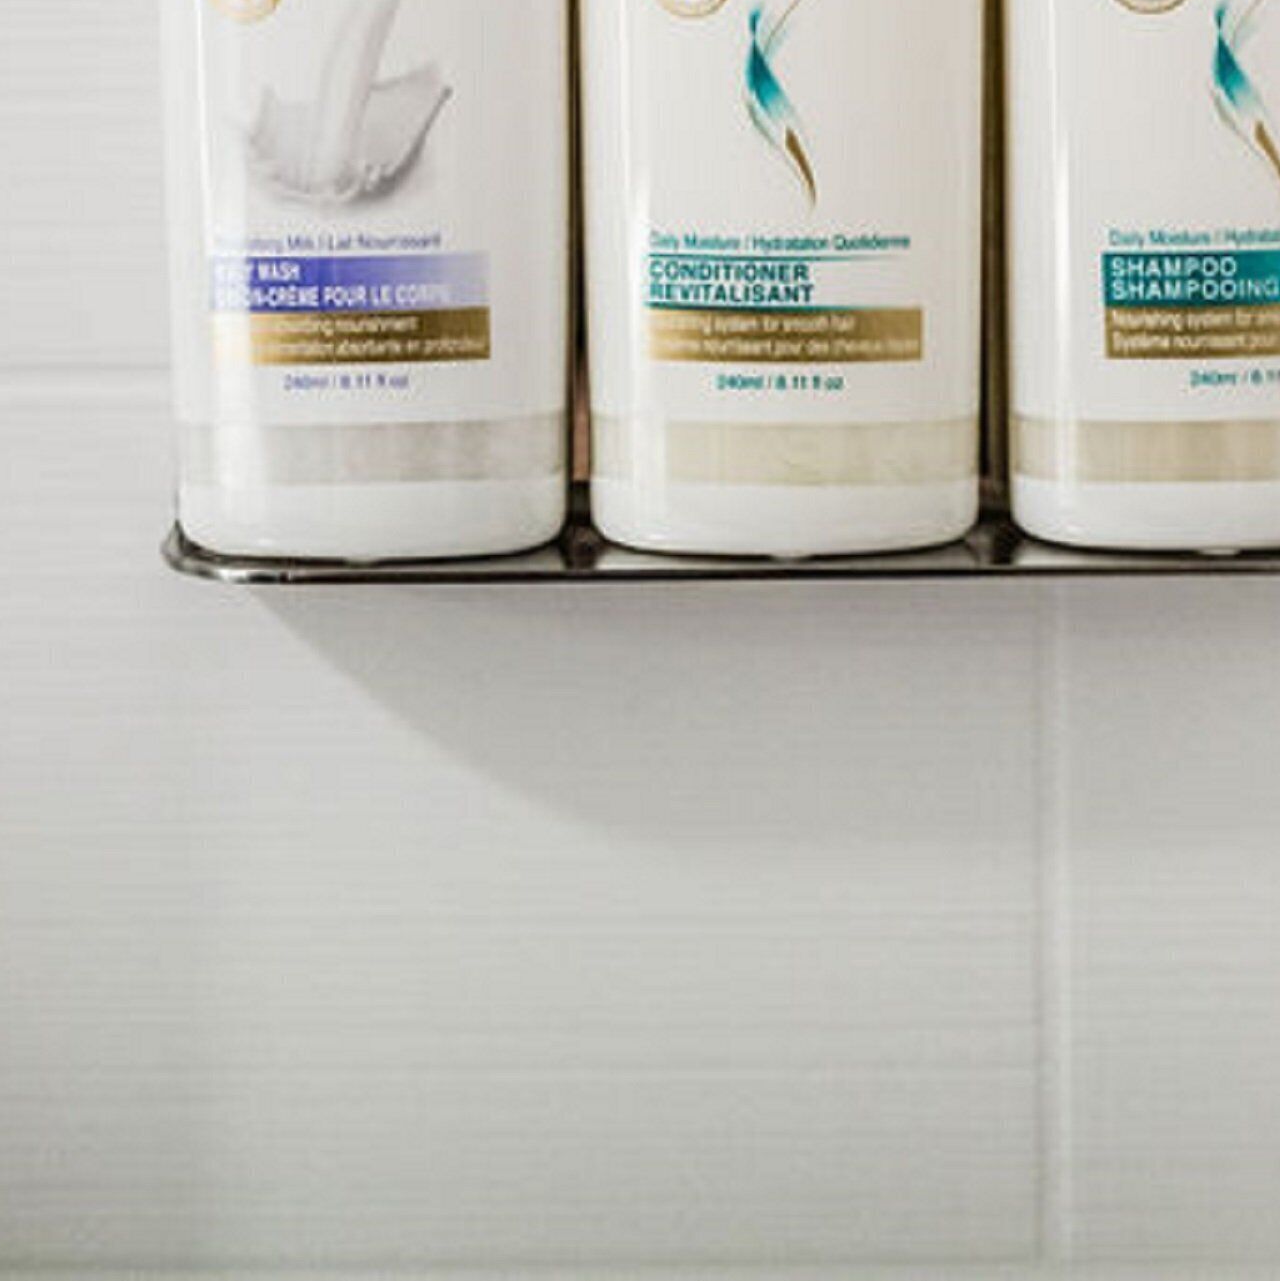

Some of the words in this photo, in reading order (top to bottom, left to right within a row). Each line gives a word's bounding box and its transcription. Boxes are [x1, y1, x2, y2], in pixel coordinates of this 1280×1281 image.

[257, 262, 300, 281] WASH
[649, 261, 811, 282] CONDITIONER
[1111, 256, 1238, 278] SHAMPOO
[324, 284, 366, 306] POUR
[370, 284, 392, 305] LE
[649, 282, 815, 303] REVITALISANT
[1111, 275, 1280, 300] SHAMPOOING
